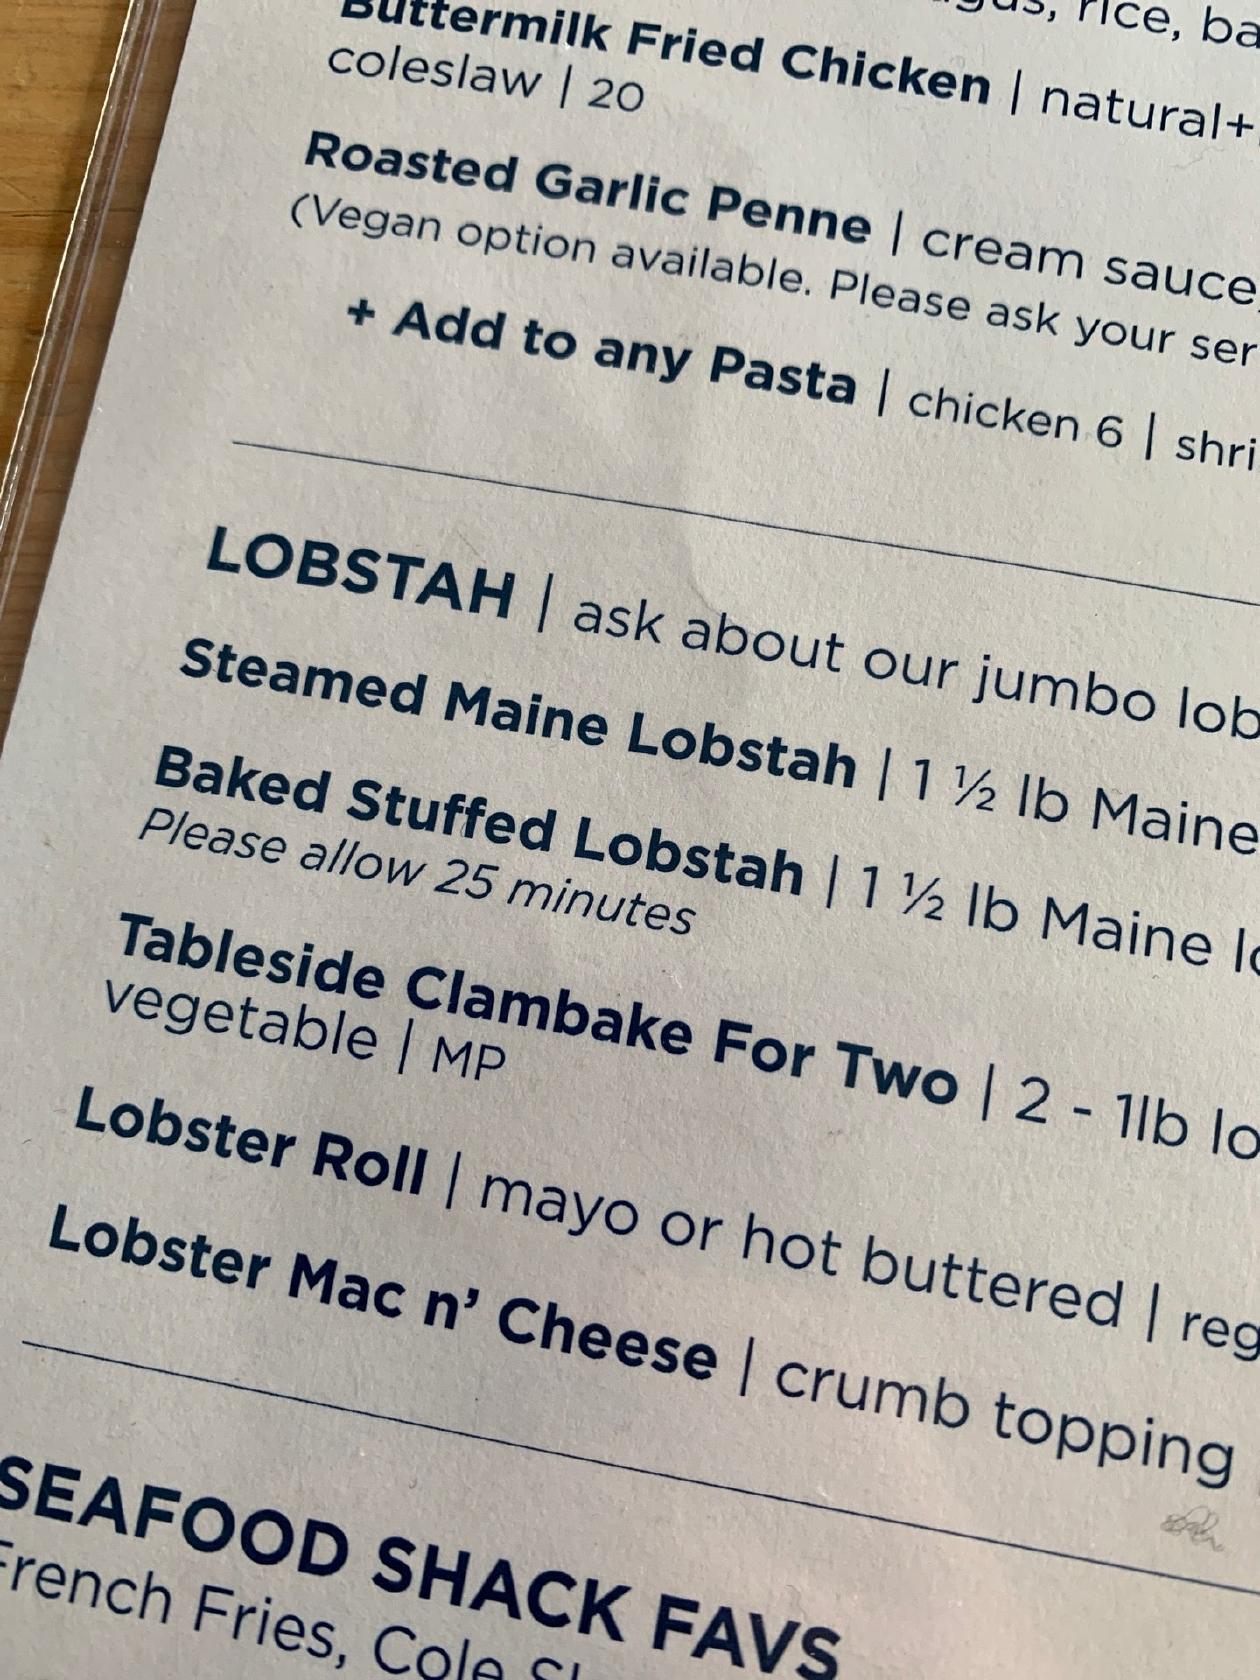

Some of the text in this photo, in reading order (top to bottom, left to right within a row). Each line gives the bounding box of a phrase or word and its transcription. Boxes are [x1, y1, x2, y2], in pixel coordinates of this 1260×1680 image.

[327, 44, 543, 99] coleslaw
[587, 77, 645, 113] 20
[340, 0, 613, 53] Buttermilk
[626, 20, 766, 74] Fried
[781, 43, 991, 106] Chicken
[1078, 0, 1181, 43] rice,
[290, 192, 1259, 367] (Vegan option available. Please ask your ser
[304, 129, 520, 194] Roasted
[535, 161, 690, 217] Garlic
[706, 181, 872, 245] Penne
[922, 228, 1084, 280] cream
[1103, 255, 1260, 314] sauce
[390, 299, 508, 351] Add
[522, 318, 578, 361] to
[593, 337, 694, 385] any
[709, 344, 857, 406] Pasta
[908, 386, 1080, 442] chicken
[1096, 414, 1124, 449] 6
[1175, 429, 1257, 472] shri
[206, 524, 516, 620] LOBSTAH
[573, 598, 666, 645] ask
[681, 611, 845, 674] about
[863, 647, 960, 690] our
[971, 653, 1157, 722] jumbo
[1178, 685, 1260, 741] lob
[178, 637, 429, 717] Steamed
[443, 680, 609, 747] Maine
[627, 710, 857, 789] Lobstah
[914, 758, 931, 801] 1
[1018, 773, 1069, 823] lb
[1091, 786, 1260, 856] Maine
[137, 807, 697, 936] Please allow 25 minutes
[154, 744, 333, 814] Baked
[345, 778, 558, 853] Stuffed
[573, 815, 804, 897] Lobstah
[862, 865, 879, 909] 1
[967, 881, 1019, 933] lb
[1041, 895, 1213, 967] Maine
[105, 979, 378, 1061] vegetable
[431, 1035, 507, 1082] MP
[119, 911, 386, 1000] Tableside
[406, 965, 693, 1056] Clambake
[713, 1018, 817, 1079] For
[835, 1039, 959, 1106] Two
[1014, 1075, 1051, 1125] 2
[1211, 1107, 1260, 1161] lo
[74, 1084, 298, 1169] Lobster
[311, 1130, 429, 1196] Roll
[479, 1174, 639, 1237] mayo
[660, 1210, 724, 1251] or
[741, 1211, 843, 1277] hot
[861, 1234, 1125, 1328] buttered
[1181, 1311, 1260, 1363] reg
[48, 1202, 273, 1290] Lobster
[287, 1251, 407, 1319] Mac
[498, 1297, 718, 1381] Cheese
[775, 1361, 971, 1430] crumb
[993, 1391, 1235, 1490] topping
[0, 1454, 842, 1680] SEAFOOD SHACK FAVS
[193, 1583, 347, 1670] Fries,
